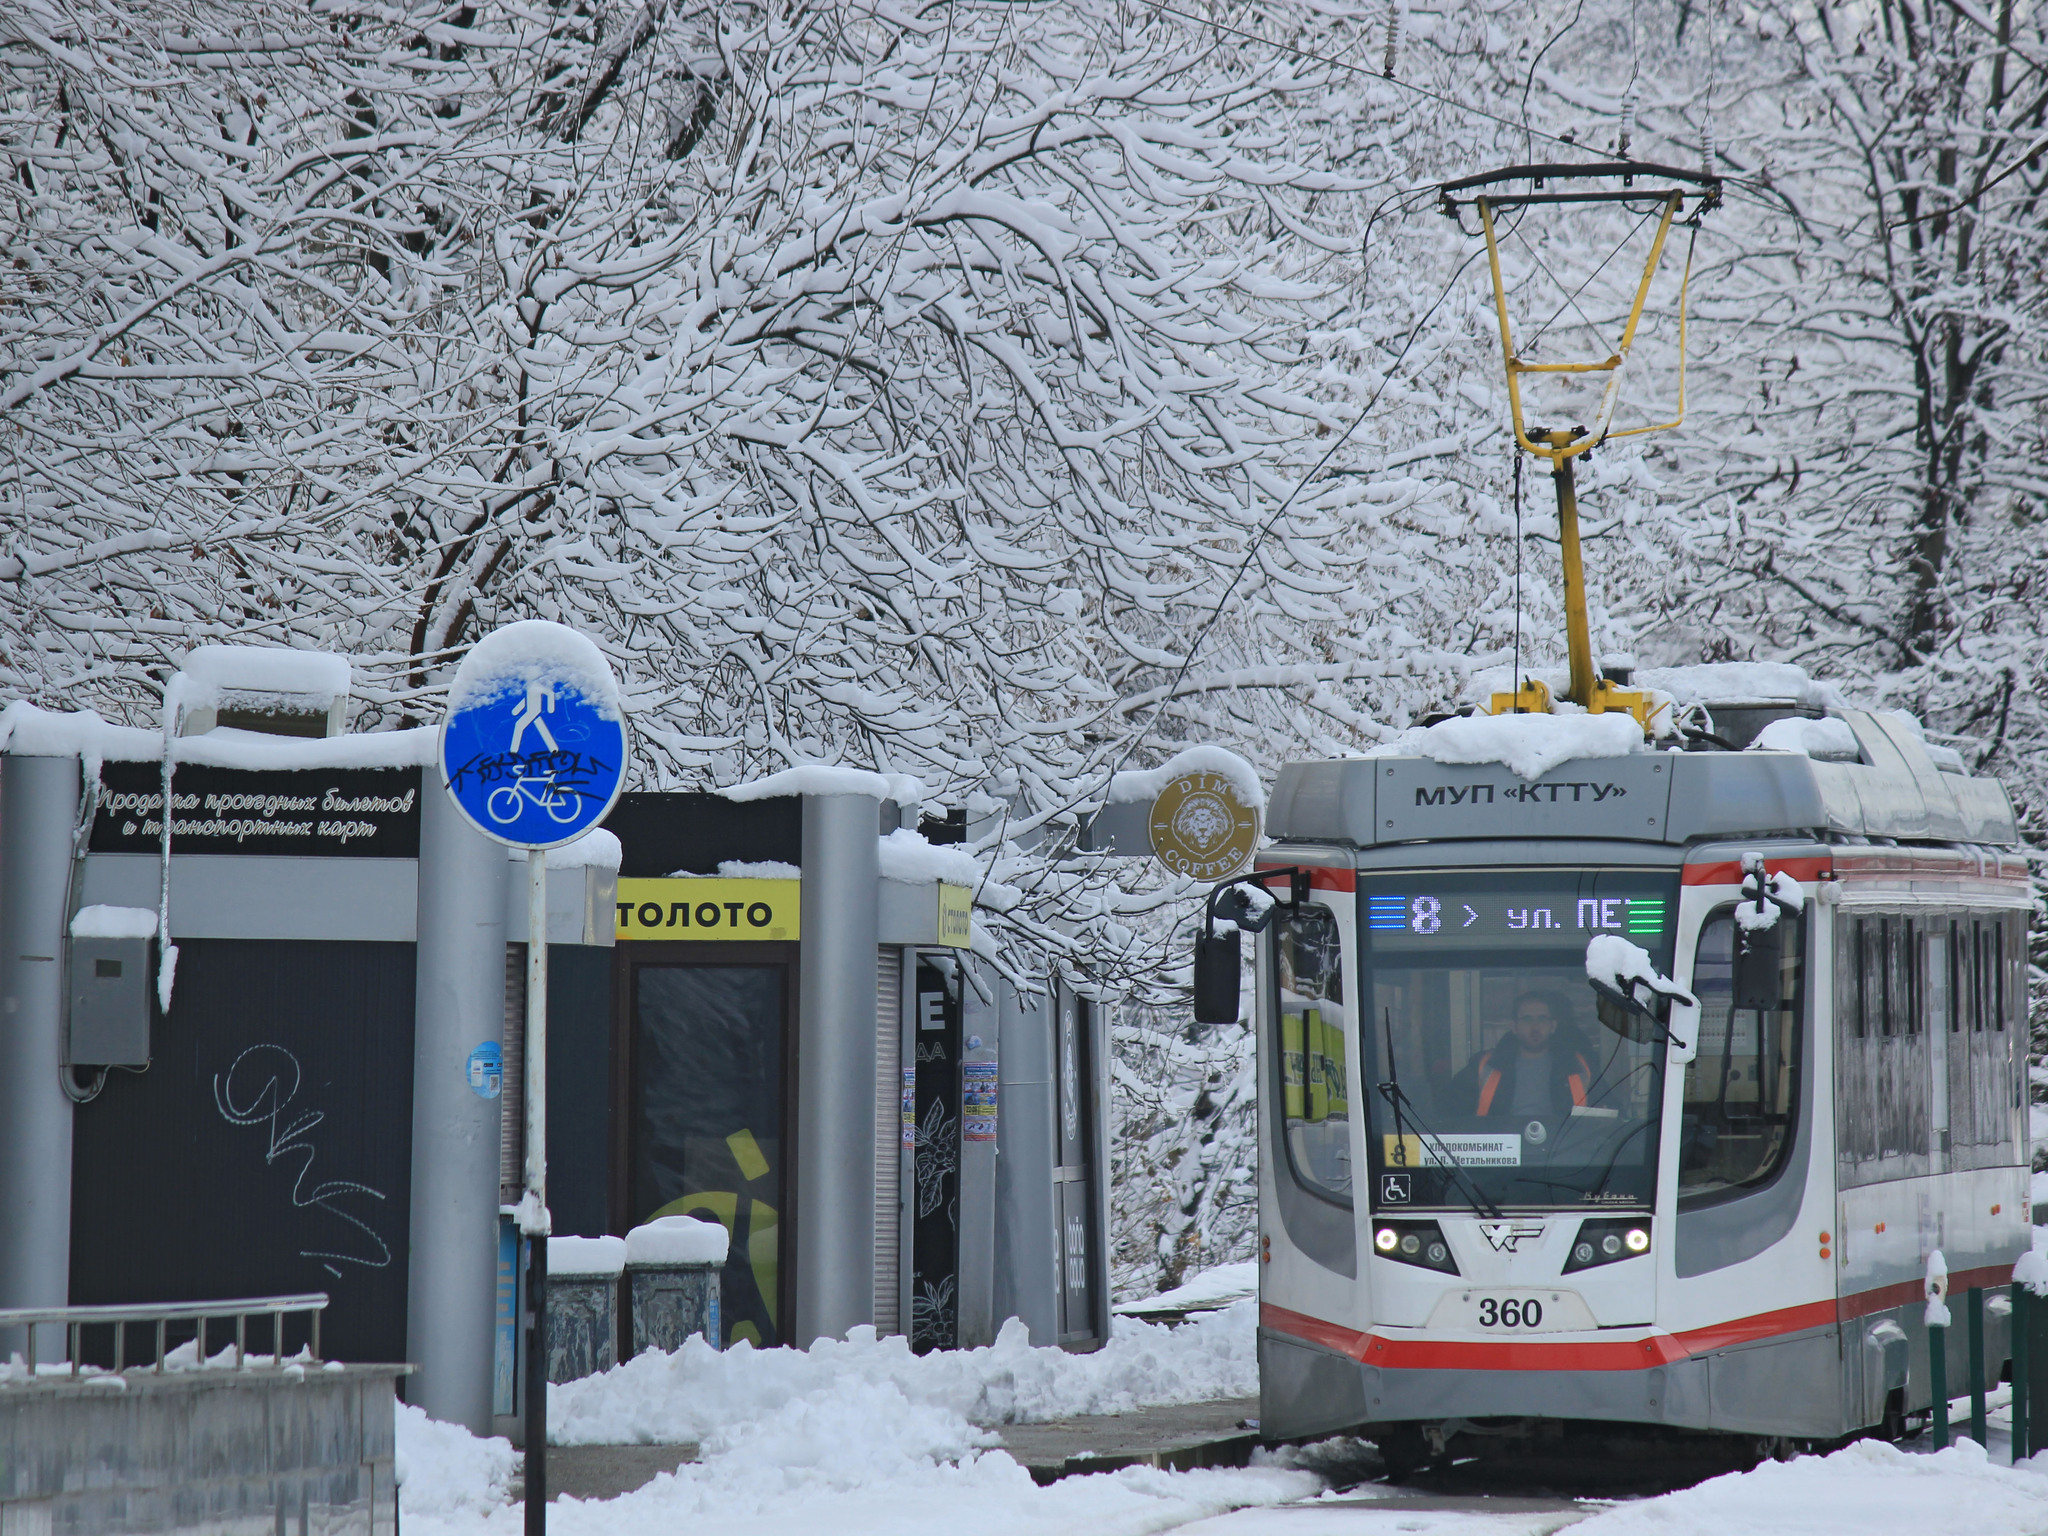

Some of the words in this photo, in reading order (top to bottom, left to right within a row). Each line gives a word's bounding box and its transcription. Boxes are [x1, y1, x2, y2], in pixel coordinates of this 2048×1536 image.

[1178, 777, 1228, 795] DIM
[1415, 784, 1494, 806] МУП
[1503, 782, 1628, 803] «КТТУ»
[205, 791, 317, 818] проездных
[321, 787, 415, 813] билетов
[122, 820, 137, 836] и
[316, 819, 377, 844] карт
[1165, 847, 1244, 876] COFFEE
[1412, 896, 1442, 934] 8
[1507, 908, 1561, 929] ул.
[1577, 898, 1631, 929] ПЕ
[1393, 1143, 1407, 1165] 8
[1479, 1298, 1543, 1328] 360
